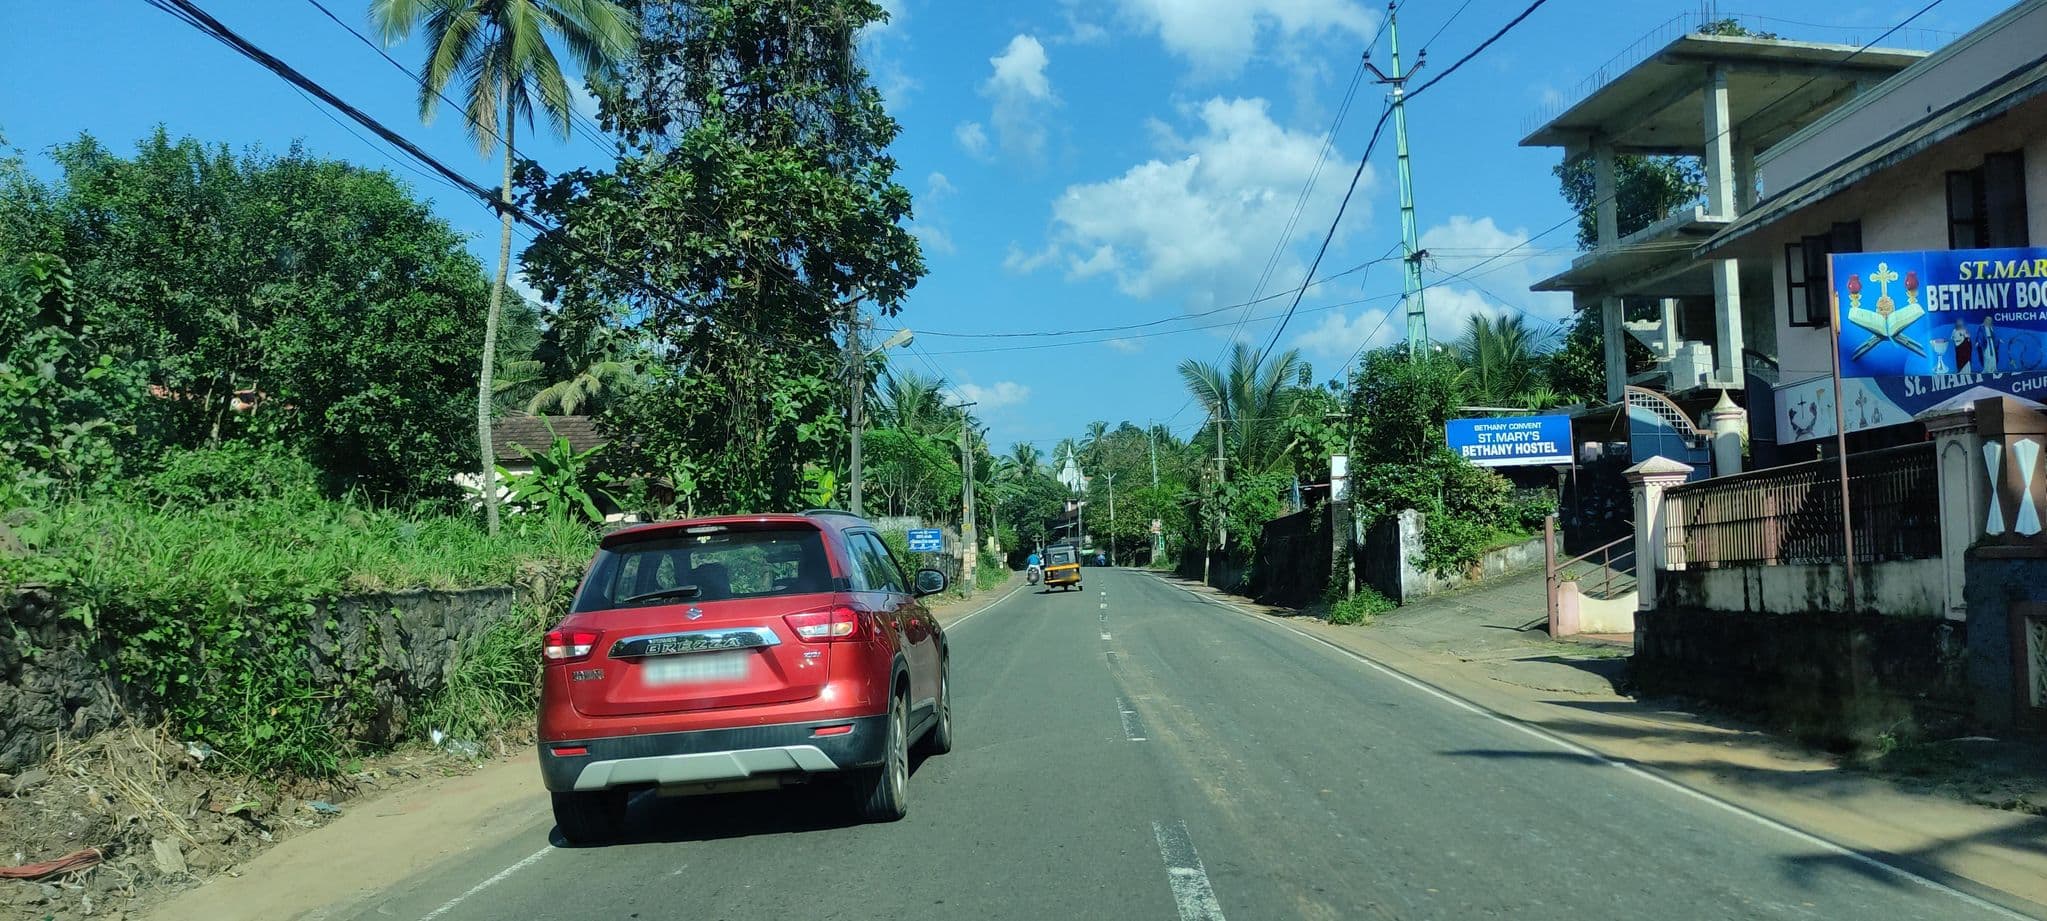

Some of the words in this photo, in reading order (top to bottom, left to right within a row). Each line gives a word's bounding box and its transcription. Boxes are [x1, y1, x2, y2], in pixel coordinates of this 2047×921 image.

[1926, 282, 2010, 312] BETHANY
[1994, 312, 2037, 322] CHURCH
[1474, 423, 1507, 432] BETHANY
[1508, 422, 1542, 431] CONVENT
[1478, 431, 1540, 443] ST.MARY'S
[1462, 443, 1513, 457] BETHANY
[1515, 441, 1558, 455] HOSTEL
[645, 637, 740, 655] BREZZA
